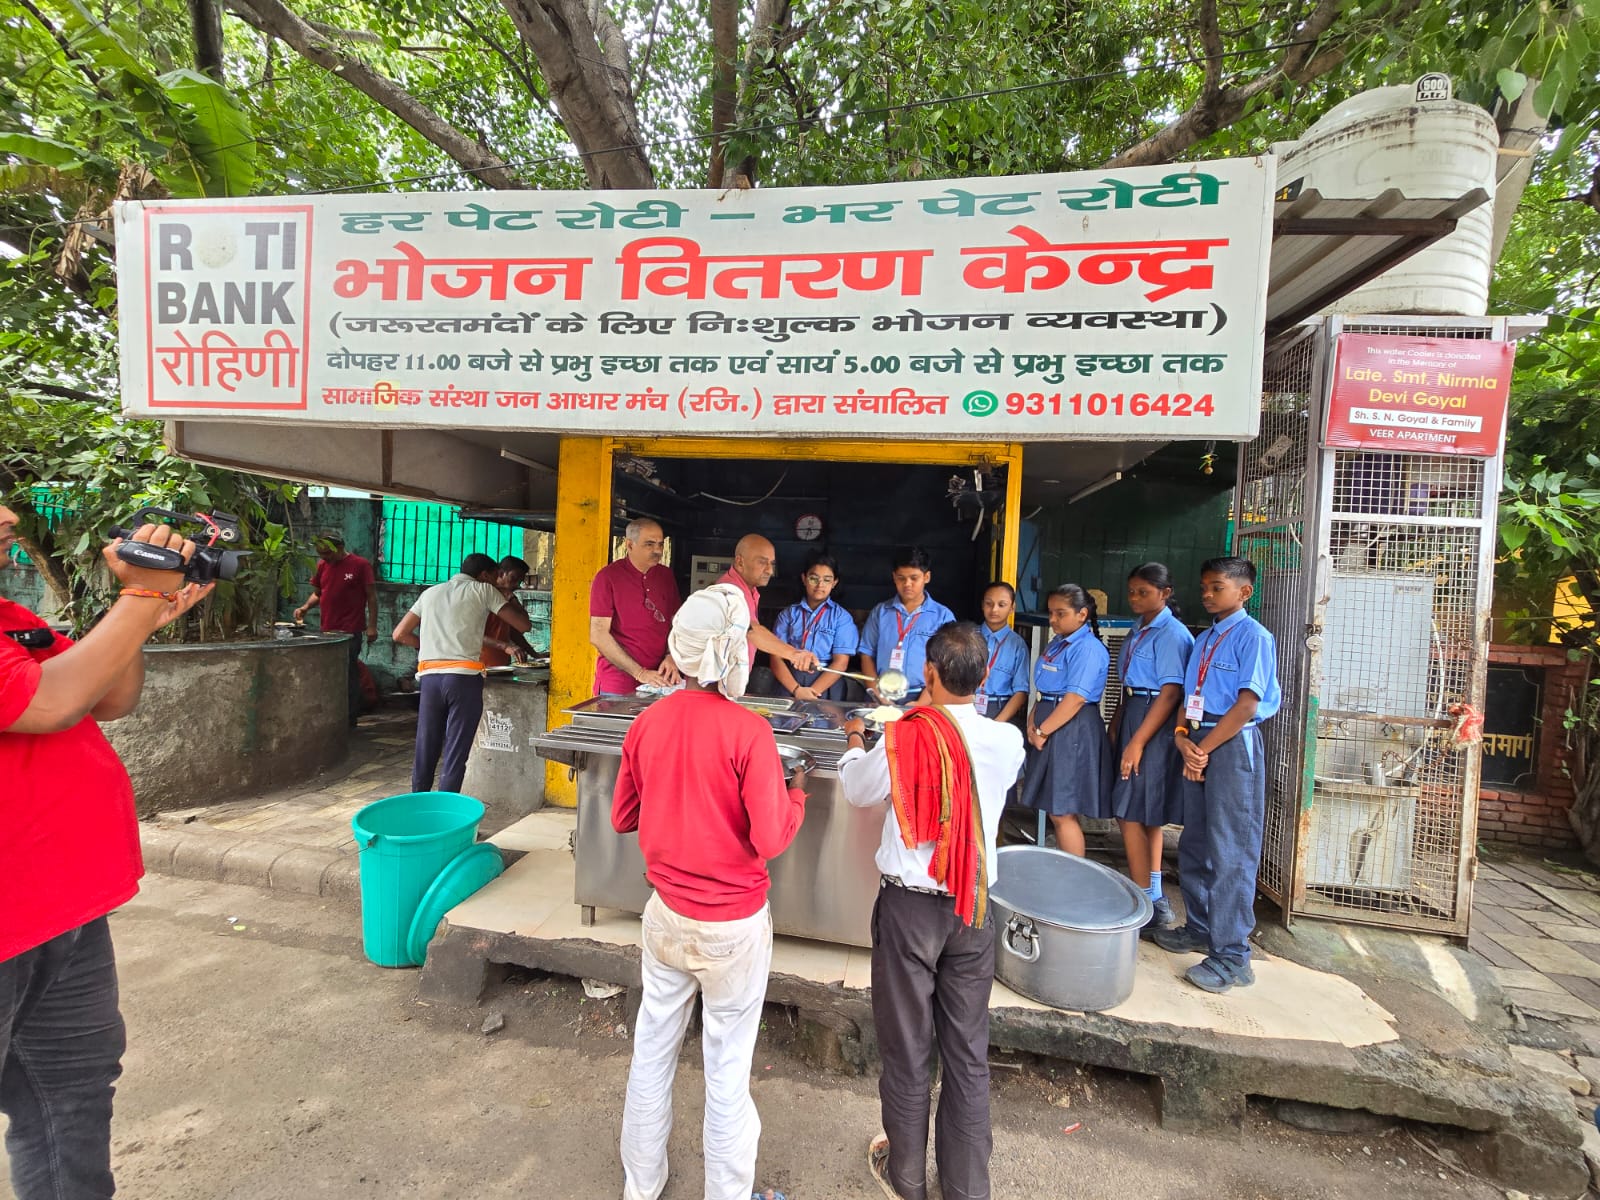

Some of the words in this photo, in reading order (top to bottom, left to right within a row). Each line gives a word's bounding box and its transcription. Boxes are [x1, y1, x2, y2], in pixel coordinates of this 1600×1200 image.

[1423, 79, 1444, 91] 500
[340, 212, 426, 234] हर
[444, 203, 543, 230] पेट
[555, 200, 689, 229] रोटी
[782, 201, 903, 223] भर
[918, 189, 1041, 216] पेट
[1057, 172, 1229, 211] रोटी
[334, 241, 593, 300] भोजन
[615, 237, 934, 300] वितरण
[960, 224, 1229, 303] केन्द्र
[159, 282, 295, 324] BANK
[545, 312, 588, 333] के
[598, 312, 676, 334] लिए
[872, 309, 1014, 331] भोजन
[155, 329, 300, 392] रोहिणी
[327, 347, 400, 371] दोपहर
[406, 354, 460, 370] 11.00
[468, 348, 513, 371] बजे
[519, 349, 544, 371] से
[550, 356, 593, 382] प्रभु
[600, 356, 662, 375] इच्छा
[669, 356, 721, 373] तक
[728, 350, 773, 374] एवं
[776, 349, 840, 374] सायं
[844, 356, 900, 373] 5.00
[909, 348, 965, 373] बजे
[973, 347, 1004, 374] से
[1012, 355, 1066, 384] प्रभु
[1074, 354, 1153, 376] इच्छा
[1162, 354, 1227, 373] तक
[1412, 360, 1446, 369] Memory
[1445, 353, 1481, 361] donated
[1346, 366, 1387, 382] Late.
[1394, 369, 1431, 385] Smt.
[1438, 373, 1498, 390] Nirmla
[322, 382, 423, 405] सामाजिक
[429, 384, 490, 407] संस्था
[495, 392, 541, 408] जन
[546, 393, 621, 410] आधार
[626, 387, 669, 411] मंच
[773, 396, 826, 415] द्वारा
[833, 388, 949, 415] संचालित
[1006, 393, 1214, 416] 9311016424
[1369, 388, 1408, 404] Devi
[1412, 391, 1467, 410] Goyal
[1354, 410, 1369, 420] Sh.
[1372, 411, 1381, 421] S.
[1383, 412, 1395, 422] N.
[1397, 413, 1429, 425] Goyal
[1431, 416, 1439, 425] &
[1441, 417, 1476, 429] Family
[1369, 428, 1394, 439] VEER
[1396, 430, 1457, 444] APARTMENT
[134, 549, 165, 561] Canon
